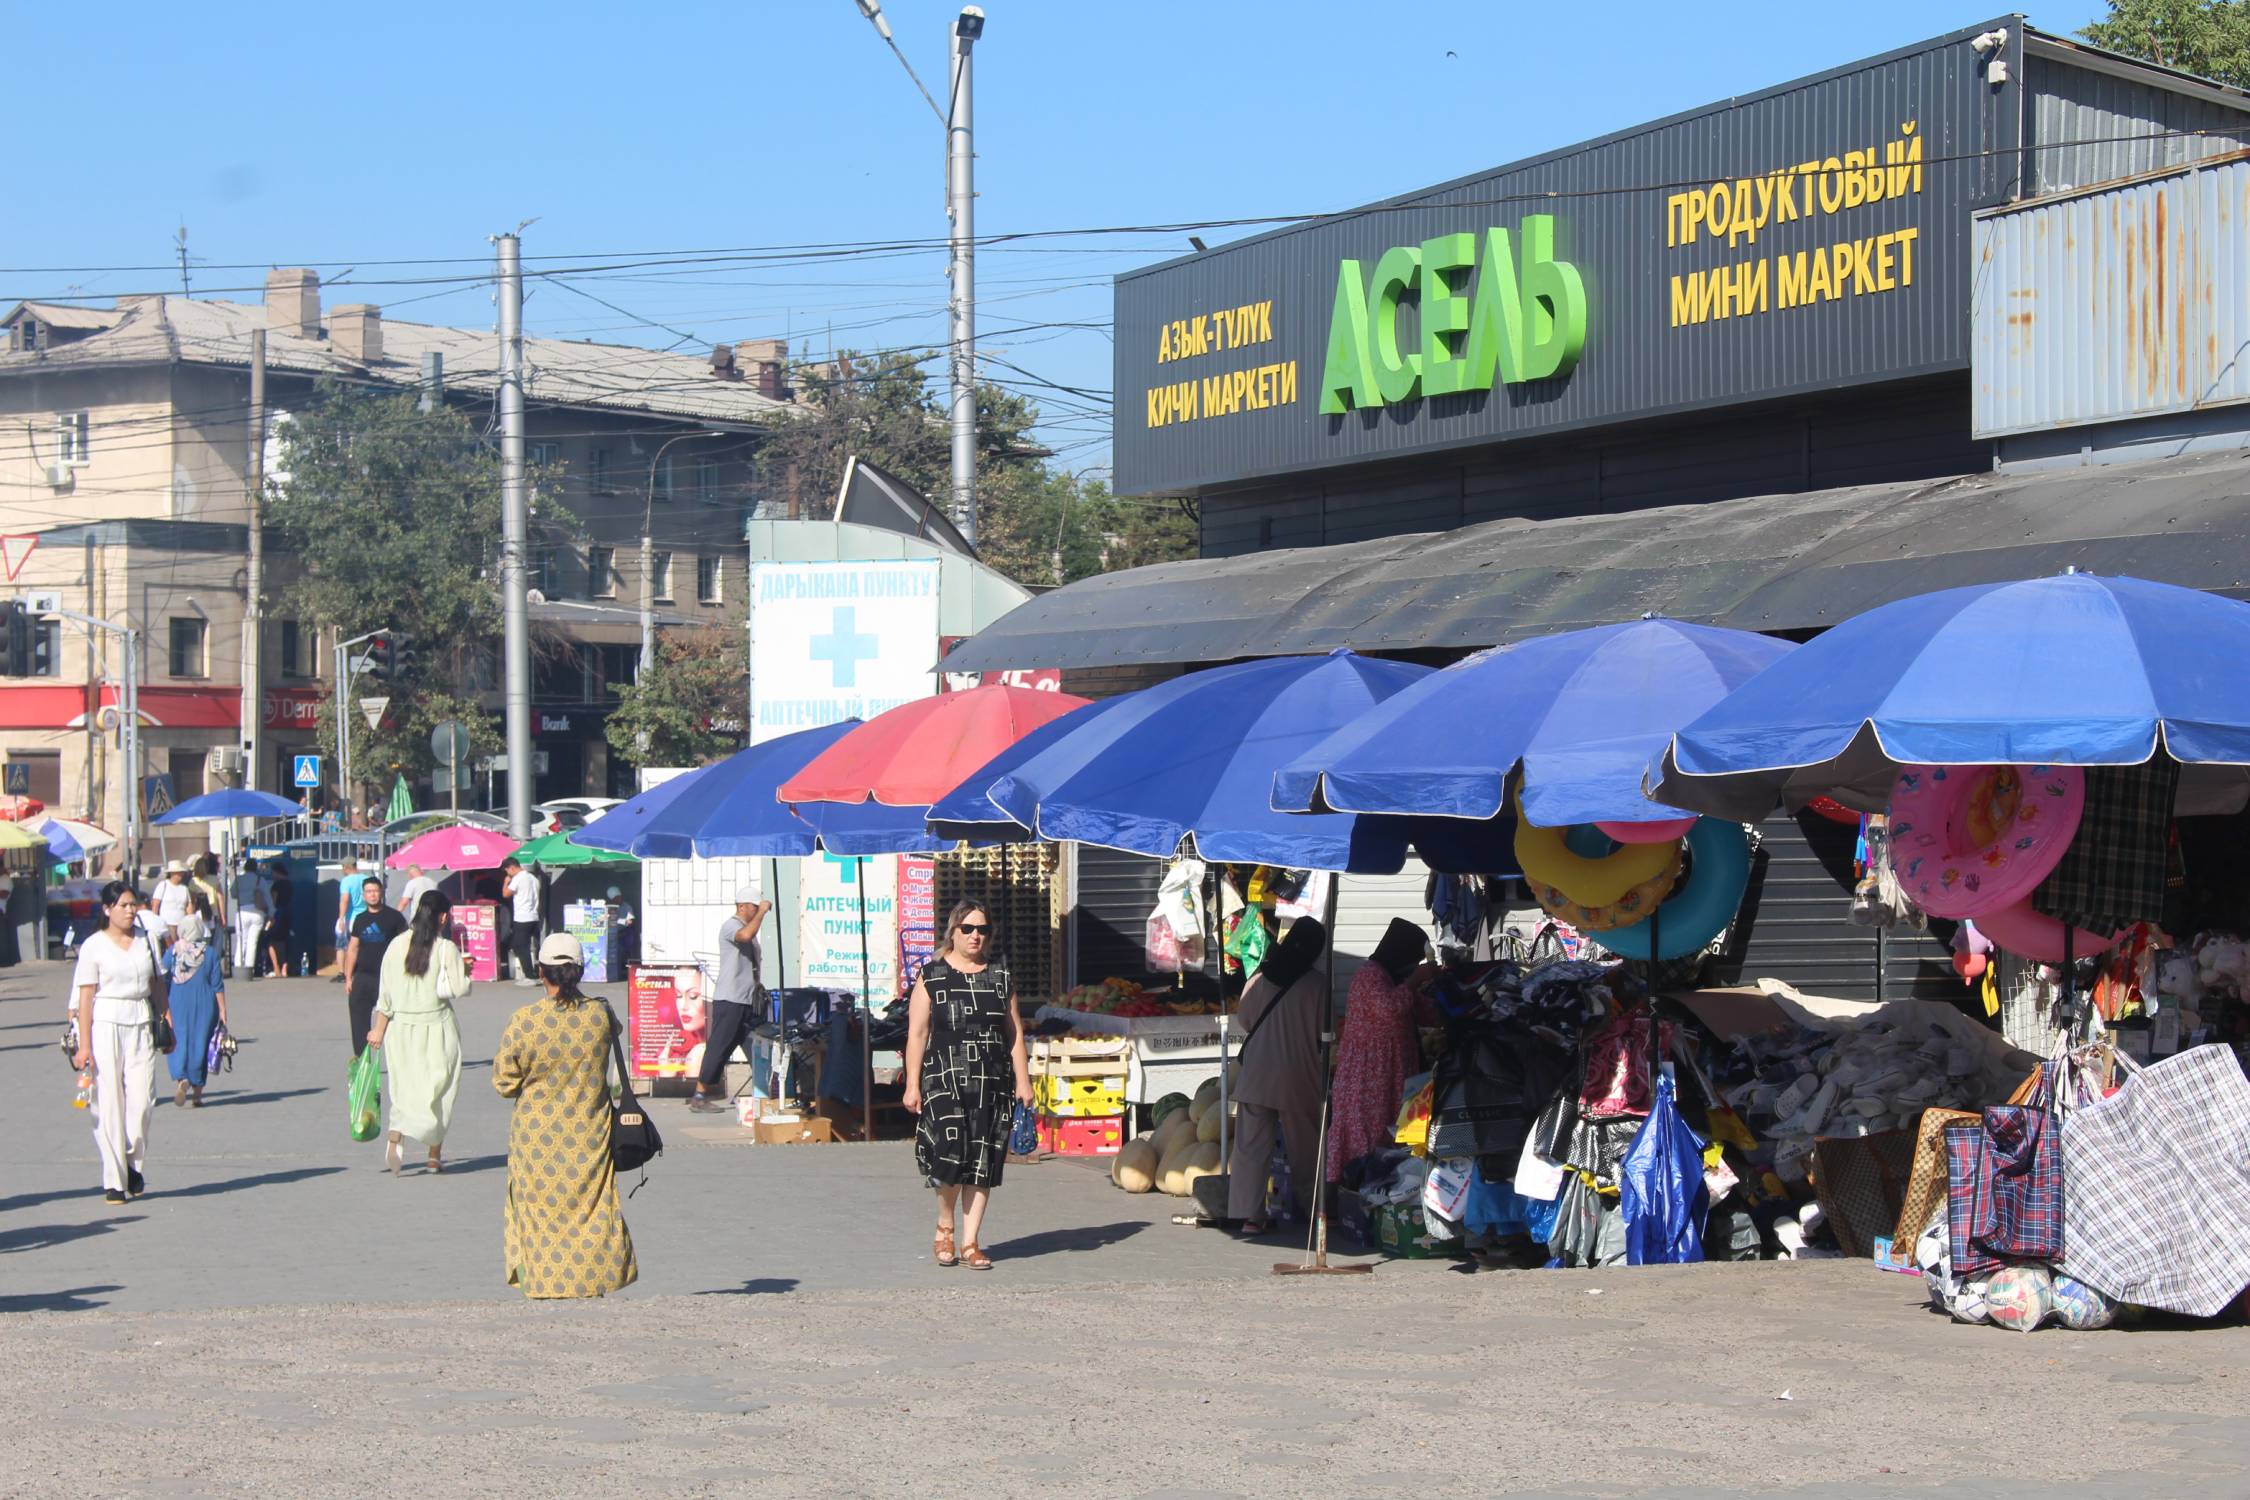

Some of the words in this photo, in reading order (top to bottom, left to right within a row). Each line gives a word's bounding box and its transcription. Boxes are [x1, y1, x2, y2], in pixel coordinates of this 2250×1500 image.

[1667, 120, 1922, 248] ПРОДУКТОВЫЙ
[1671, 258, 1768, 328] МИНИ
[1777, 227, 1918, 310] МАРКЕТ
[1319, 214, 1587, 415] АСЕЛЬ
[1147, 380, 1199, 429] КИЧИ
[1203, 360, 1297, 418] МАРКЕТИ
[760, 572, 860, 602] ДАРЫКАНА
[863, 571, 932, 598] ПУНКТУ
[282, 697, 320, 719] Demi
[541, 715, 571, 731] Bank
